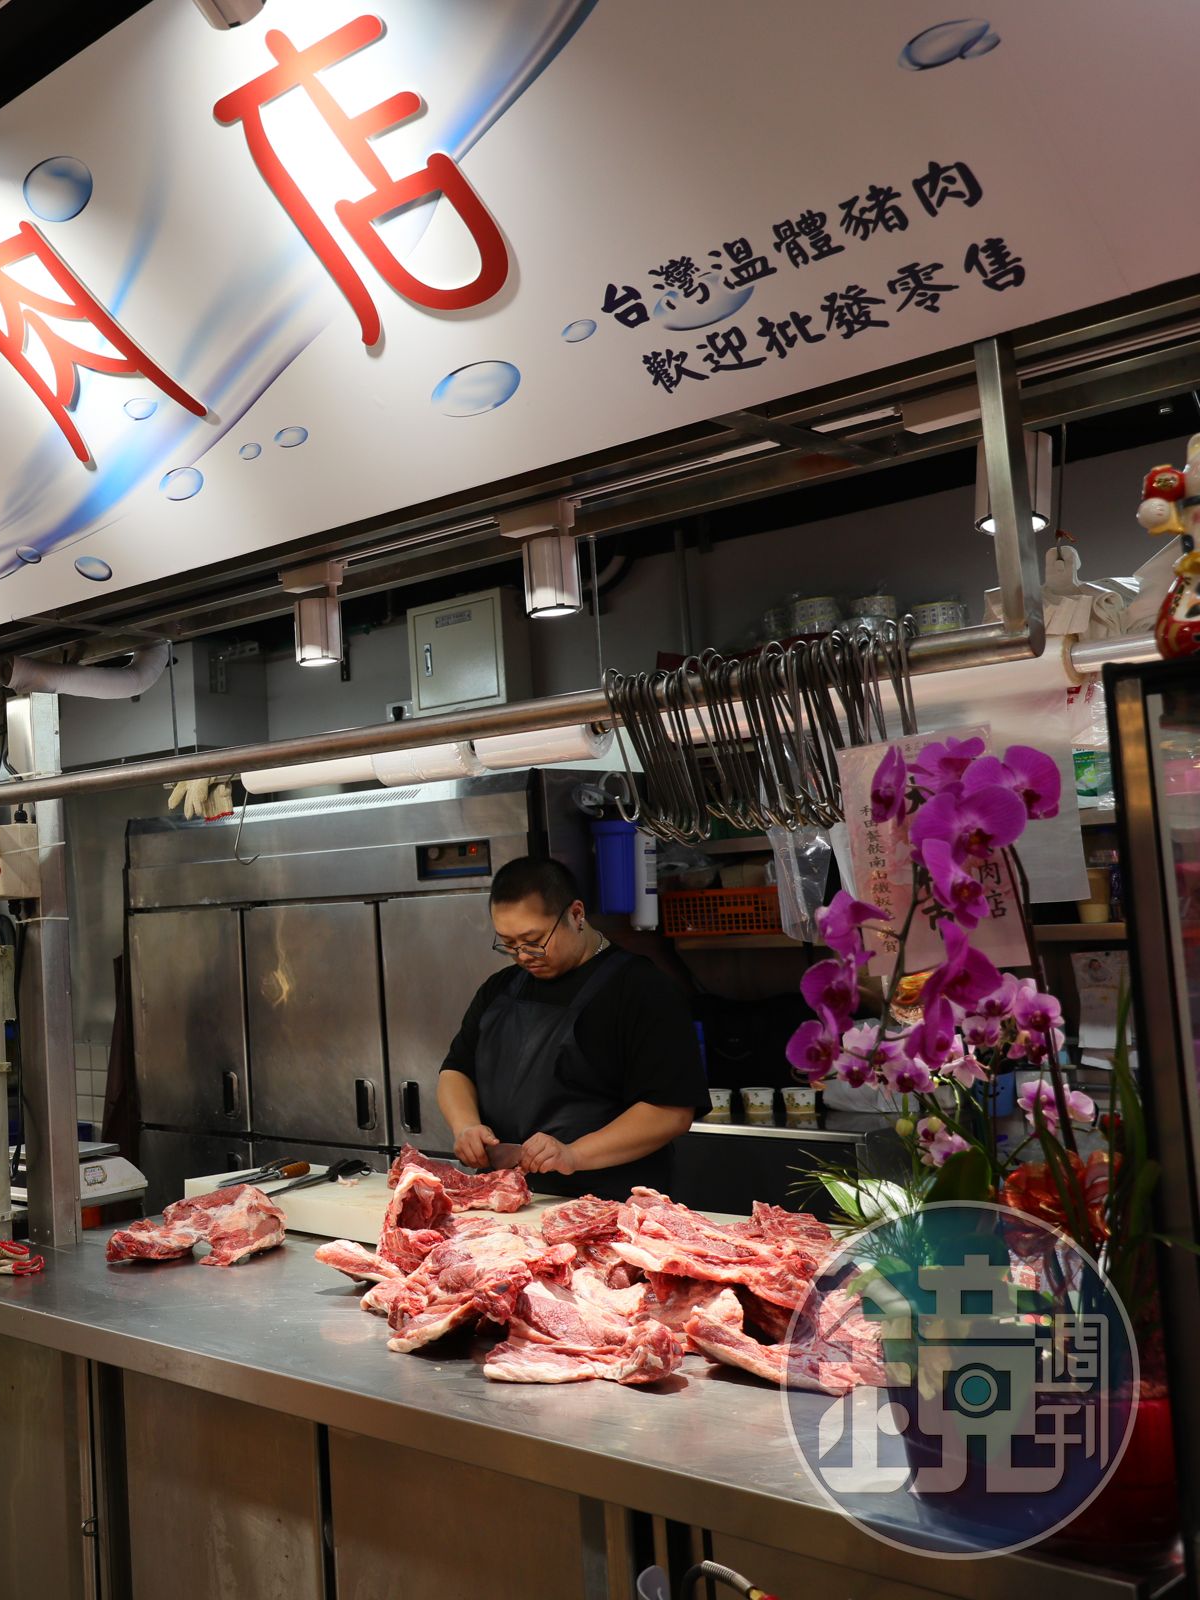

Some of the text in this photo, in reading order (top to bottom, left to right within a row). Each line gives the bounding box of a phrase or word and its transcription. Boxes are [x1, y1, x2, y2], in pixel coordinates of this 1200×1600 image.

[601, 161, 983, 329] 台灣溫體豬肉
[642, 237, 1026, 394] 歡迎批發零售
